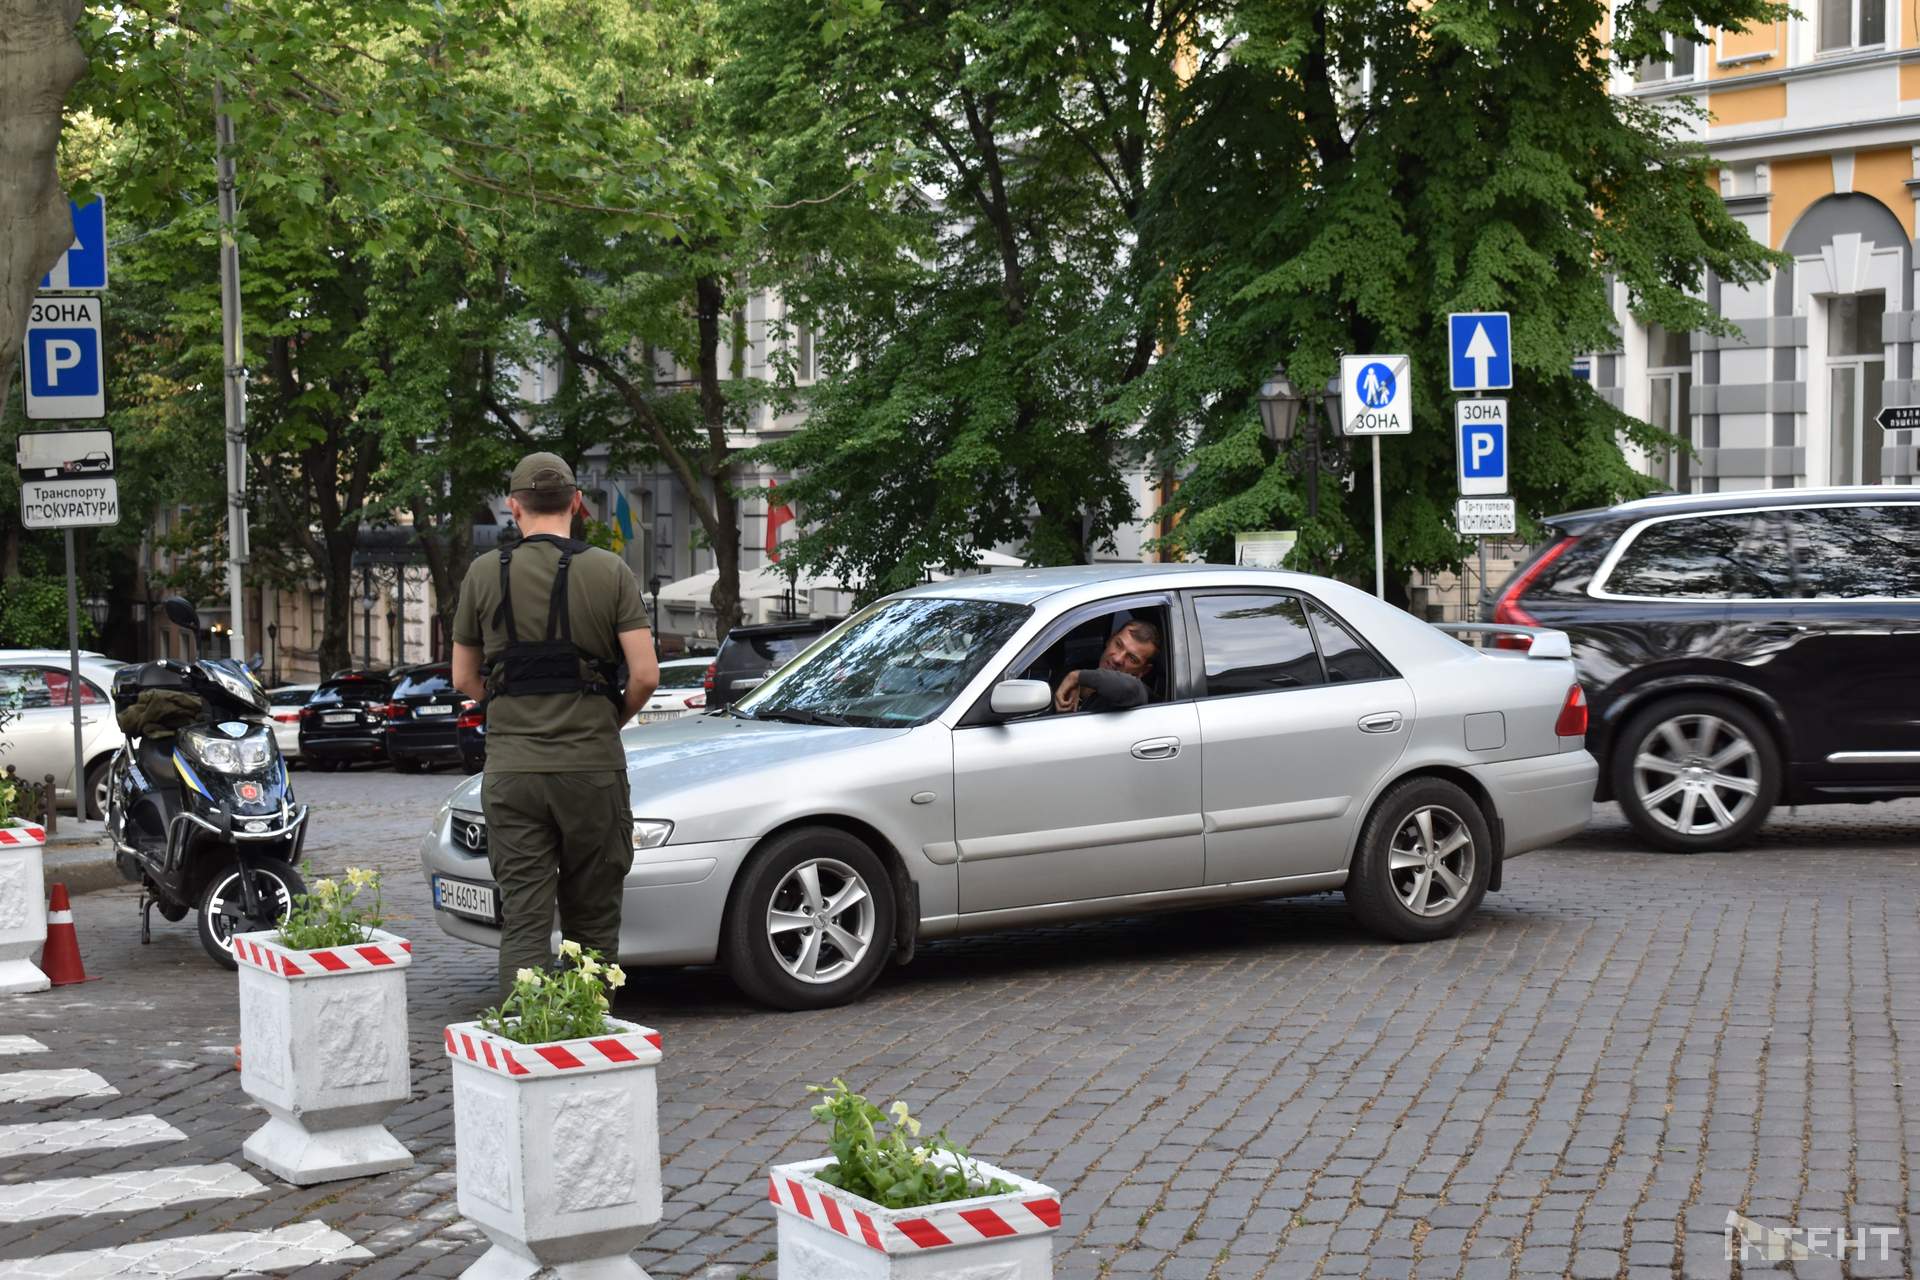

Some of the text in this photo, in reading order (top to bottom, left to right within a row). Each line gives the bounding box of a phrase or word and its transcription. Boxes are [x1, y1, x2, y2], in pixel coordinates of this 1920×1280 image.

[31, 304, 92, 322] ЗОНА
[45, 339, 82, 387] P
[1355, 413, 1400, 429] ЗОНА
[1464, 405, 1502, 420] ЗОНА
[1471, 432, 1495, 470] P
[33, 487, 106, 502] Транспорту
[440, 882, 455, 905] BH
[456, 886, 478, 910] 6603
